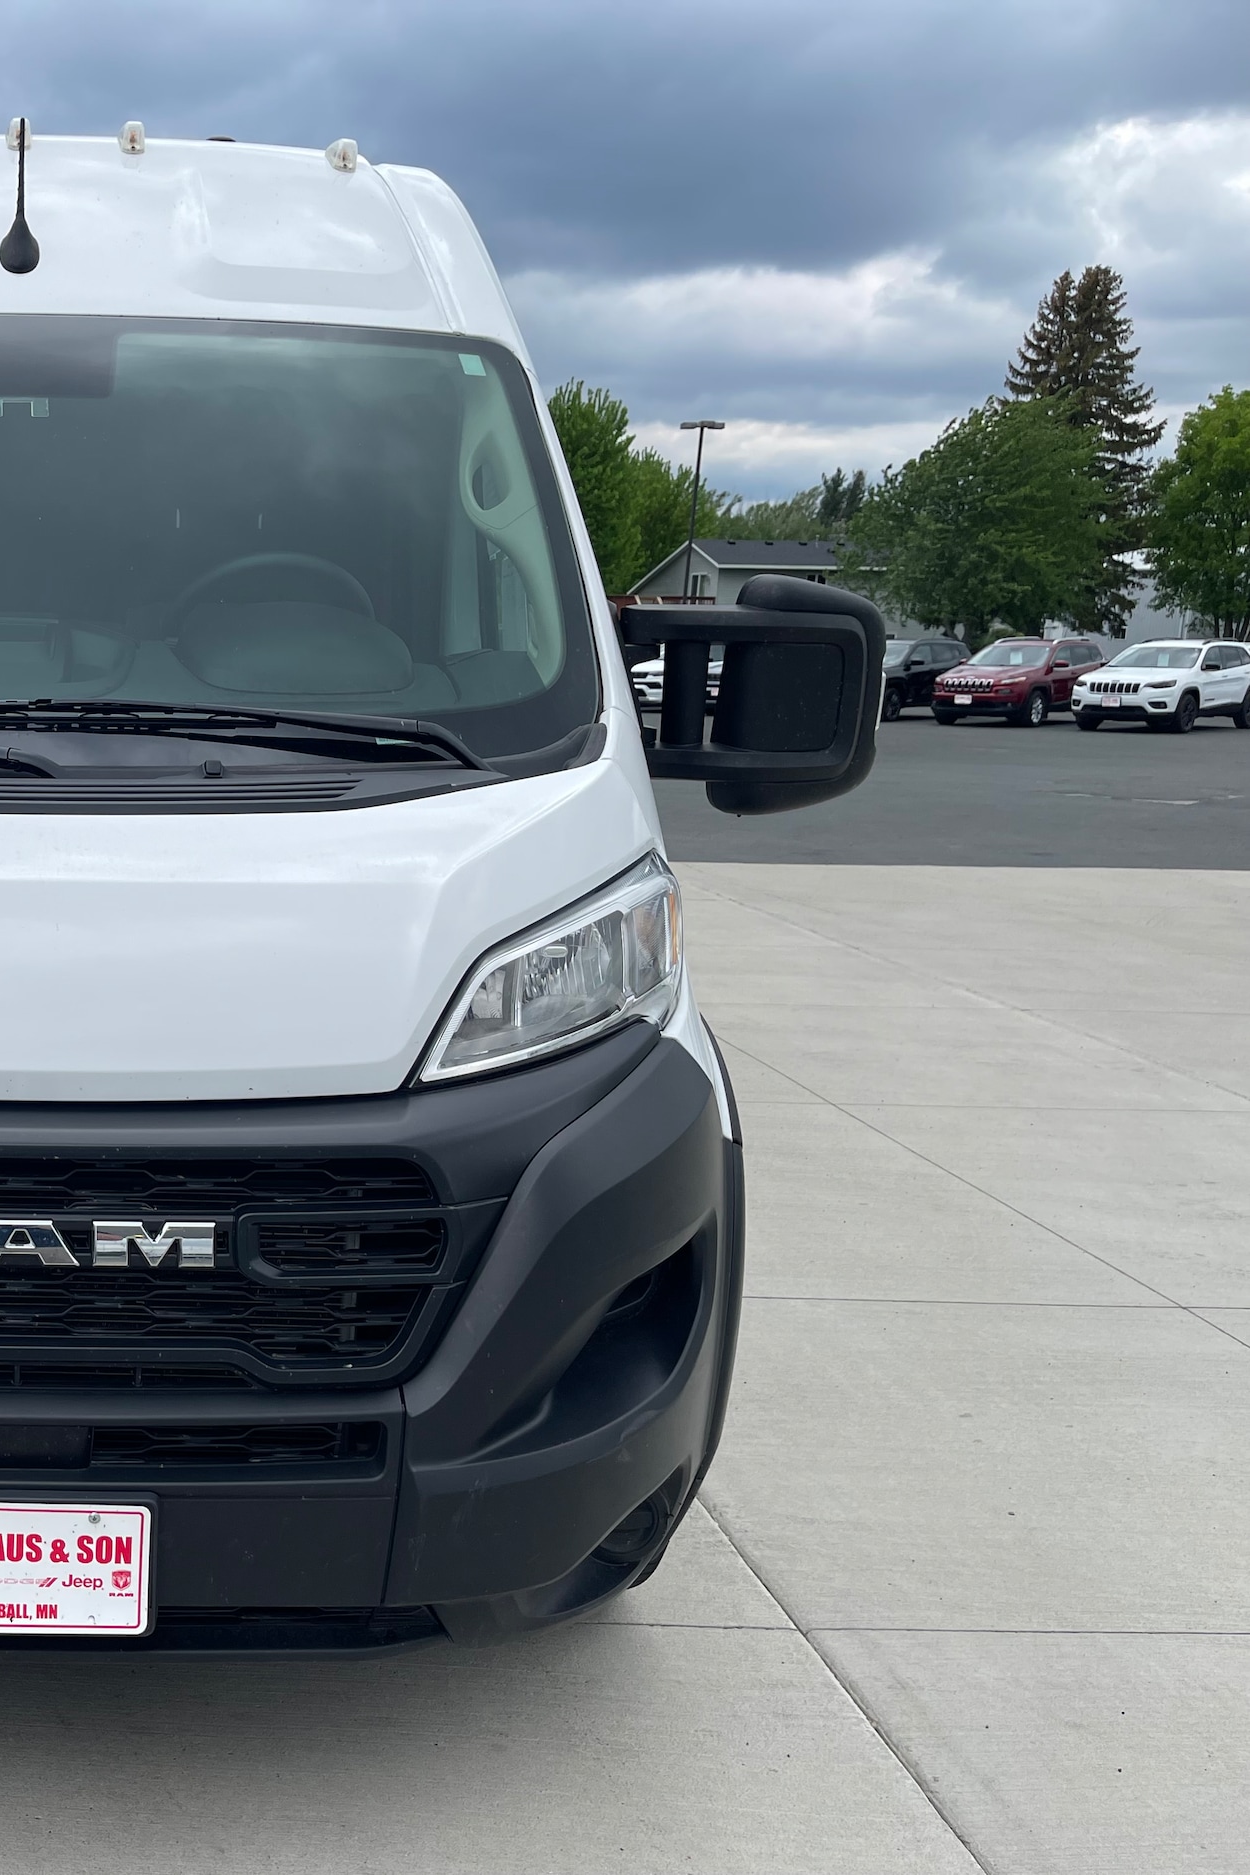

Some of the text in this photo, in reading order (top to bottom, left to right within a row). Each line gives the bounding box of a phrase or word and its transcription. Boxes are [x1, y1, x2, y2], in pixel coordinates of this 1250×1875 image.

[49, 1539, 70, 1563] &
[76, 1535, 132, 1565] SON
[61, 1574, 103, 1590] Jeep
[36, 1604, 58, 1619] MN
